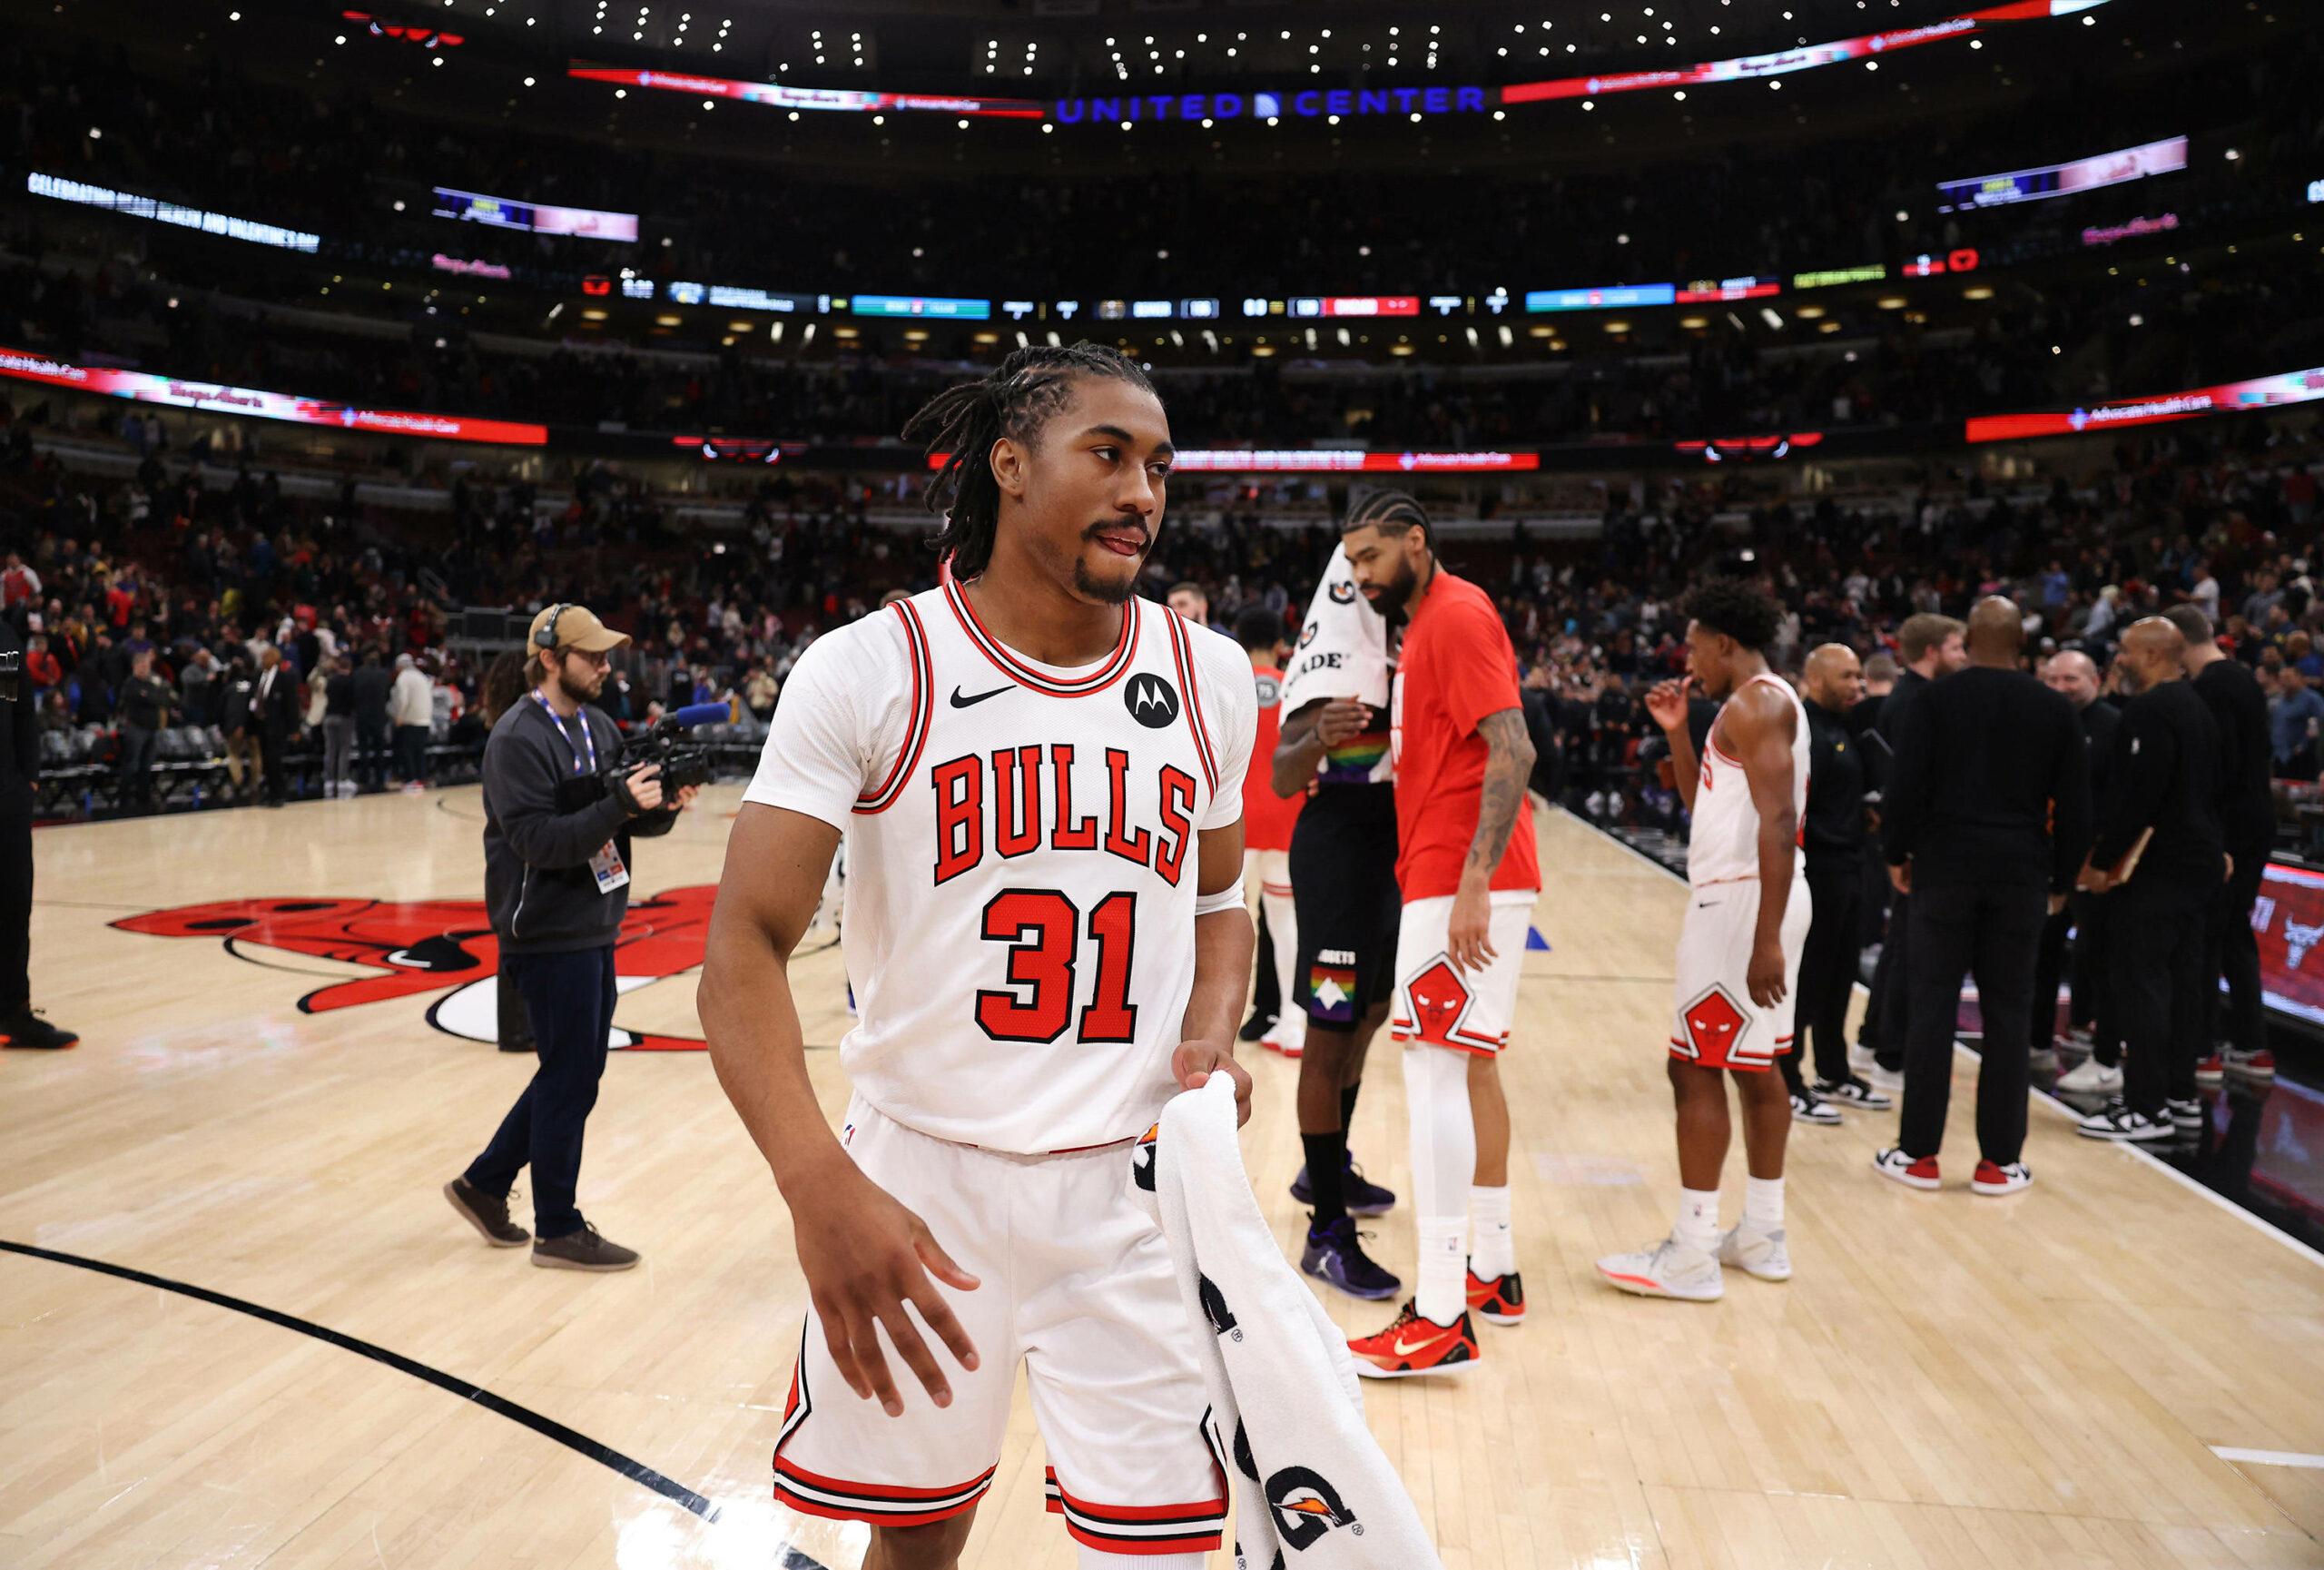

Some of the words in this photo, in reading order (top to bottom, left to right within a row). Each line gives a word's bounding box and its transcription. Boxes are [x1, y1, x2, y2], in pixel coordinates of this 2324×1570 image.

[1056, 94, 1243, 123] UNITED
[1294, 86, 1485, 116] CENTER
[202, 212, 228, 235] AND
[931, 743, 1196, 888] BULLS
[974, 887, 1138, 1045] 31
